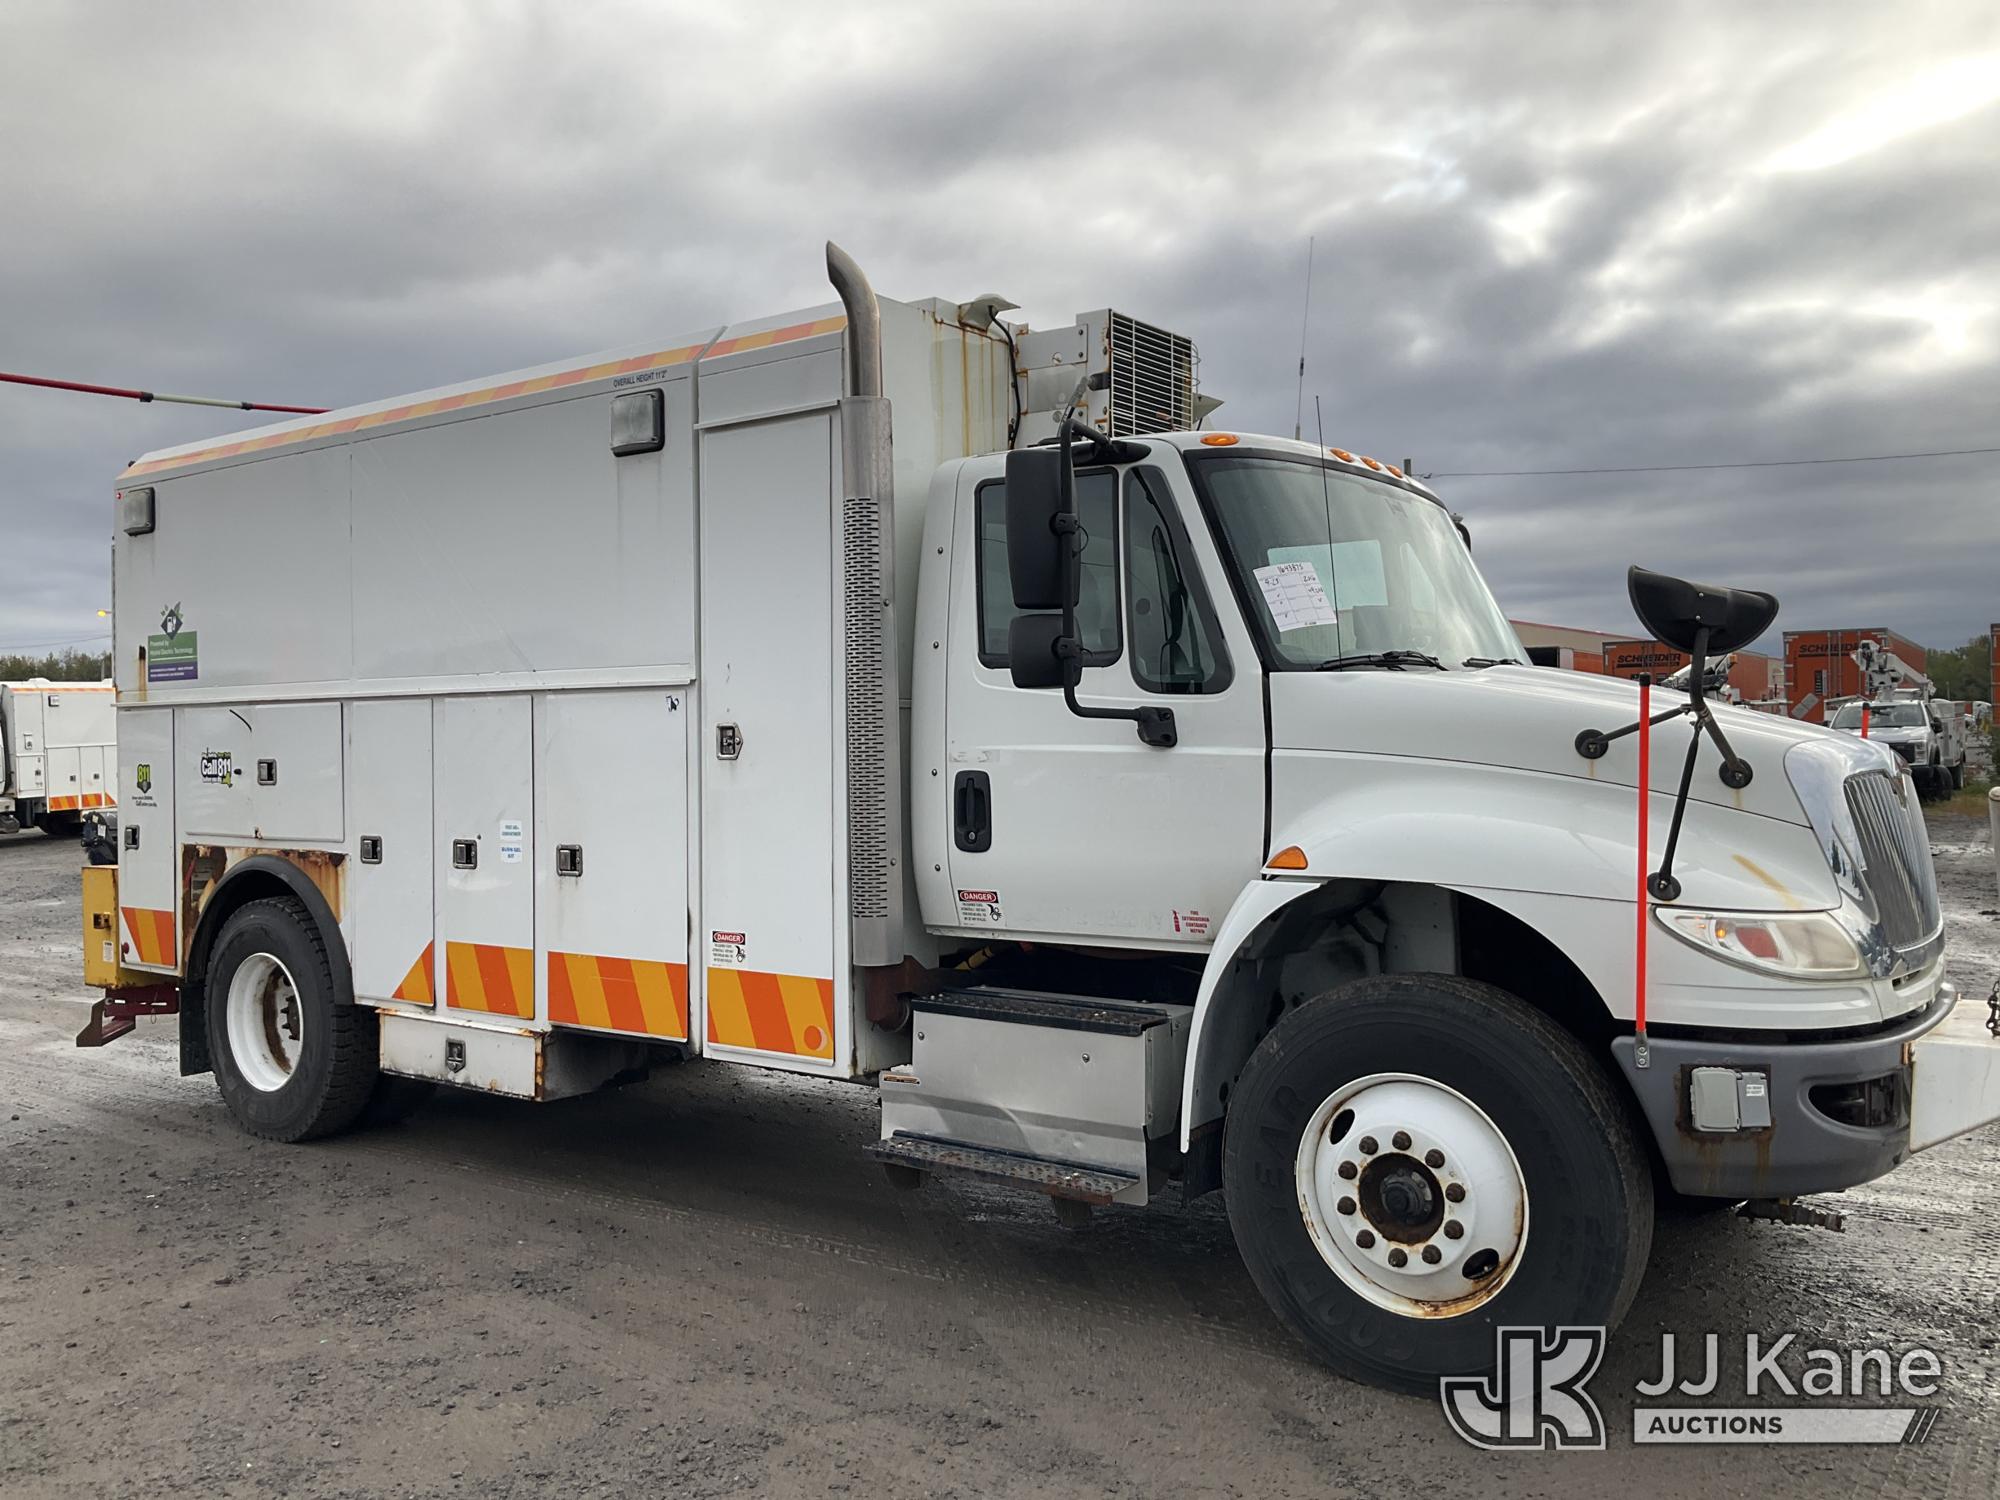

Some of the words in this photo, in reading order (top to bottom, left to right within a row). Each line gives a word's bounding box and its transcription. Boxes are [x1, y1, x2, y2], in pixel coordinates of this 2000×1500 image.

[613, 376, 635, 388] OVERALL
[636, 371, 654, 383] HEIGHT
[1617, 653, 1681, 663] SCHNEIDER
[137, 764, 150, 782] 811
[202, 759, 218, 775] Call
[218, 758, 231, 777] 811
[963, 892, 993, 901] DANGER
[717, 933, 741, 942] DANGER
